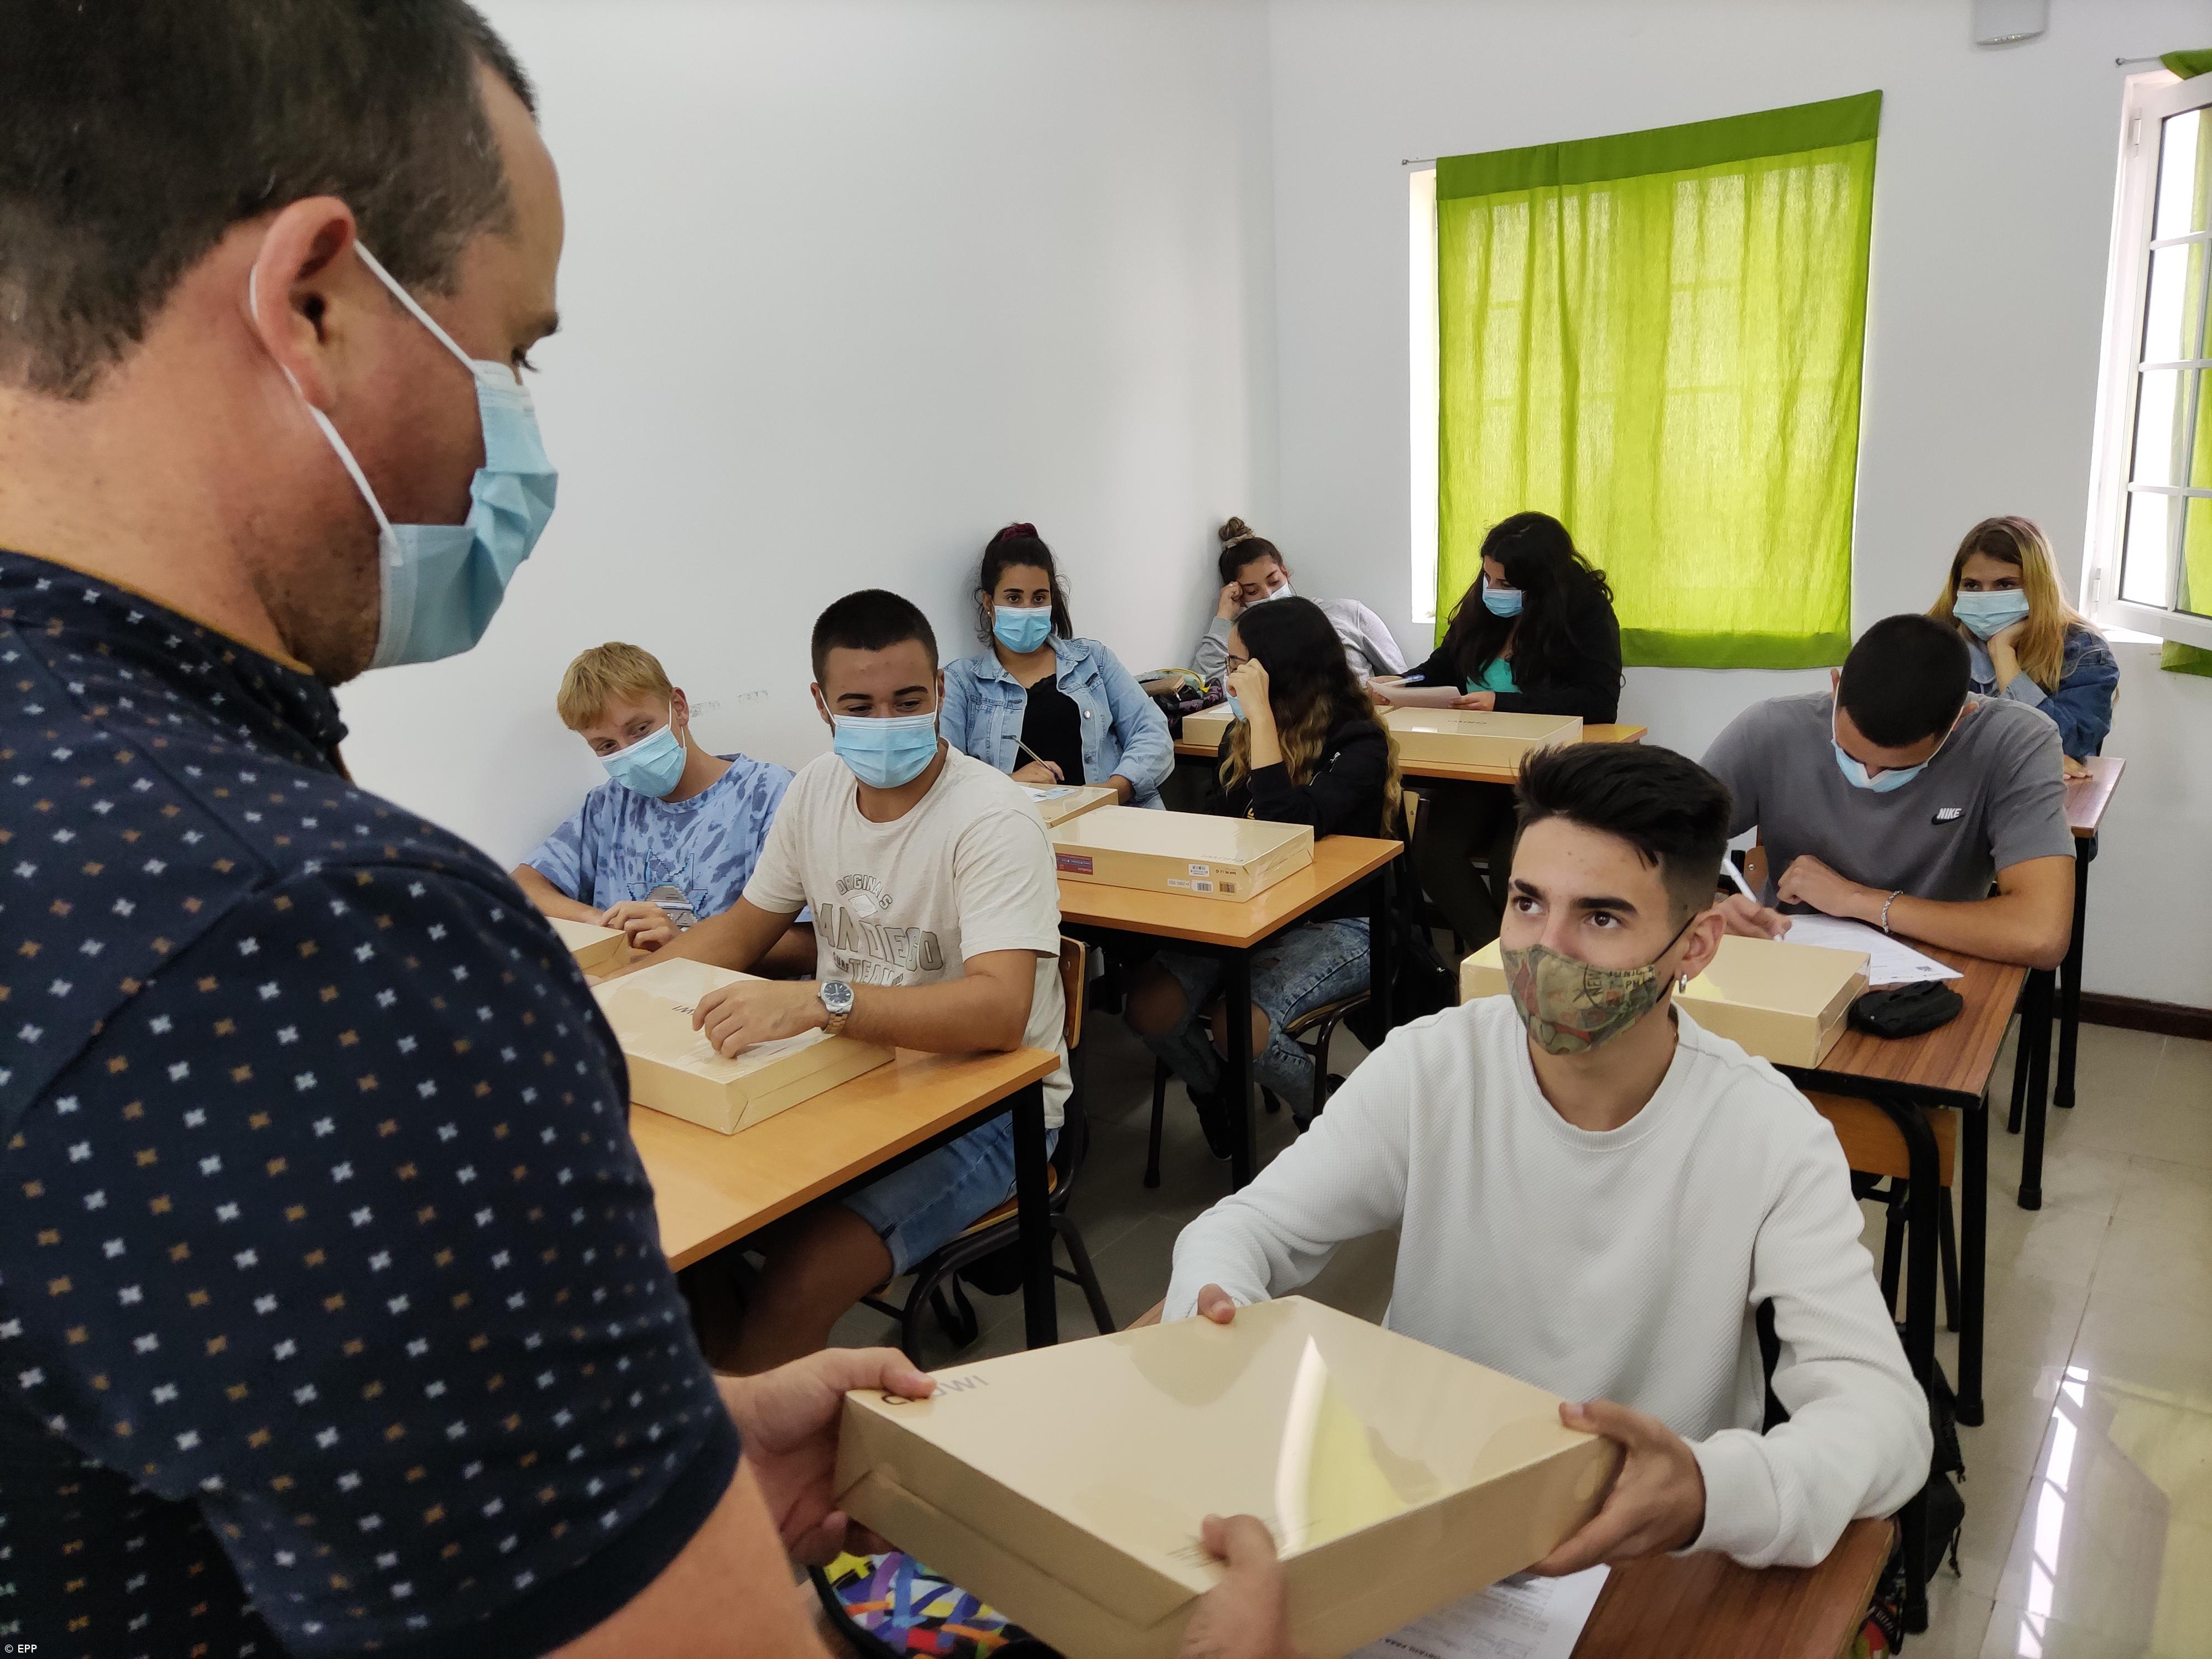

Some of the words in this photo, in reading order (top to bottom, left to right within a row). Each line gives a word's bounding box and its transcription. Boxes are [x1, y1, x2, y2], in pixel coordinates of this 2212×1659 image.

[1937, 807, 1962, 820] NIKE
[836, 874, 893, 910] ORIGINAS
[812, 897, 859, 953] AN
[858, 920, 944, 972] DIEGO
[881, 1375, 990, 1405] CUWI
